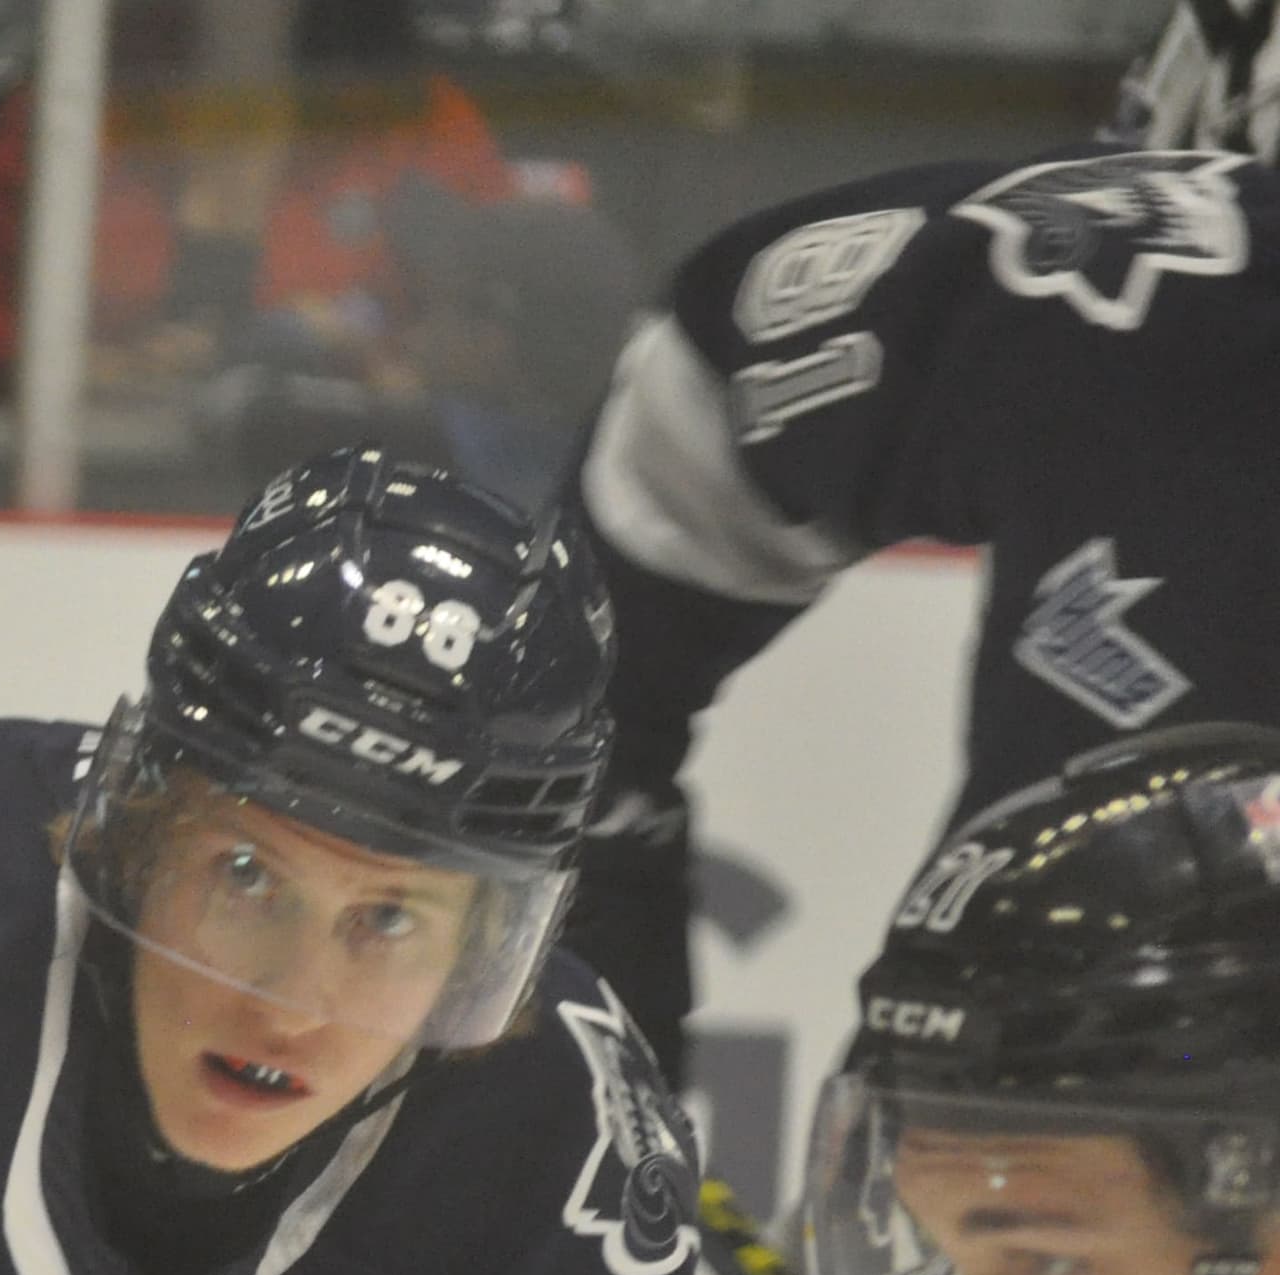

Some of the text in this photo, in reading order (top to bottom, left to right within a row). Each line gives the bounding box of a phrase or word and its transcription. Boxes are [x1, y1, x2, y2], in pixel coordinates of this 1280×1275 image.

[362, 579, 481, 671] 88
[299, 707, 464, 785] CCM
[867, 997, 966, 1043] CCM
